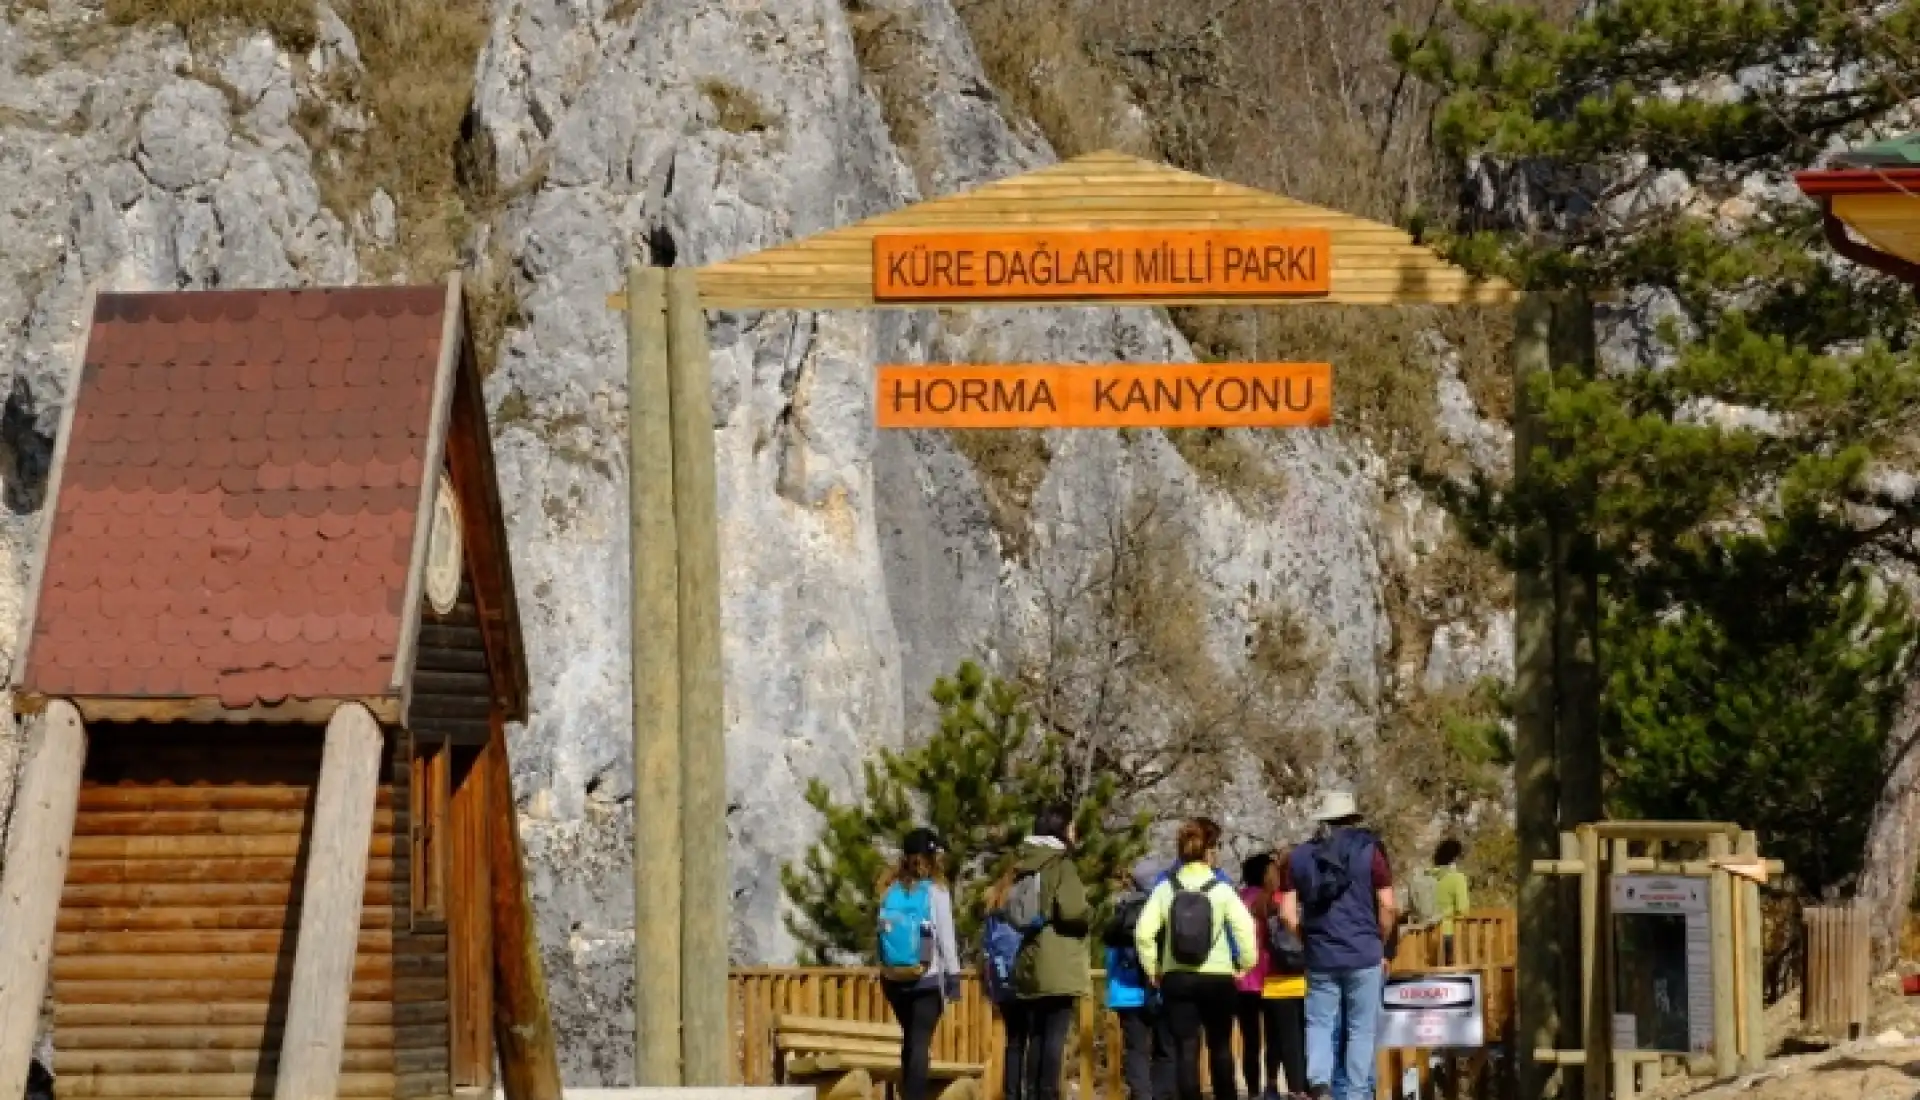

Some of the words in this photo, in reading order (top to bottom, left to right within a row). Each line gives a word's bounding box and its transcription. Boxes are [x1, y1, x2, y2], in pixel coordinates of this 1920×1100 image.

[887, 244, 974, 286] KÜRE
[986, 242, 1122, 285] DAĞLARI
[1135, 241, 1212, 284] MİLLİ
[1223, 245, 1316, 283] PARKI
[894, 378, 1056, 412] HORMA
[1095, 376, 1313, 412] KANYONU
